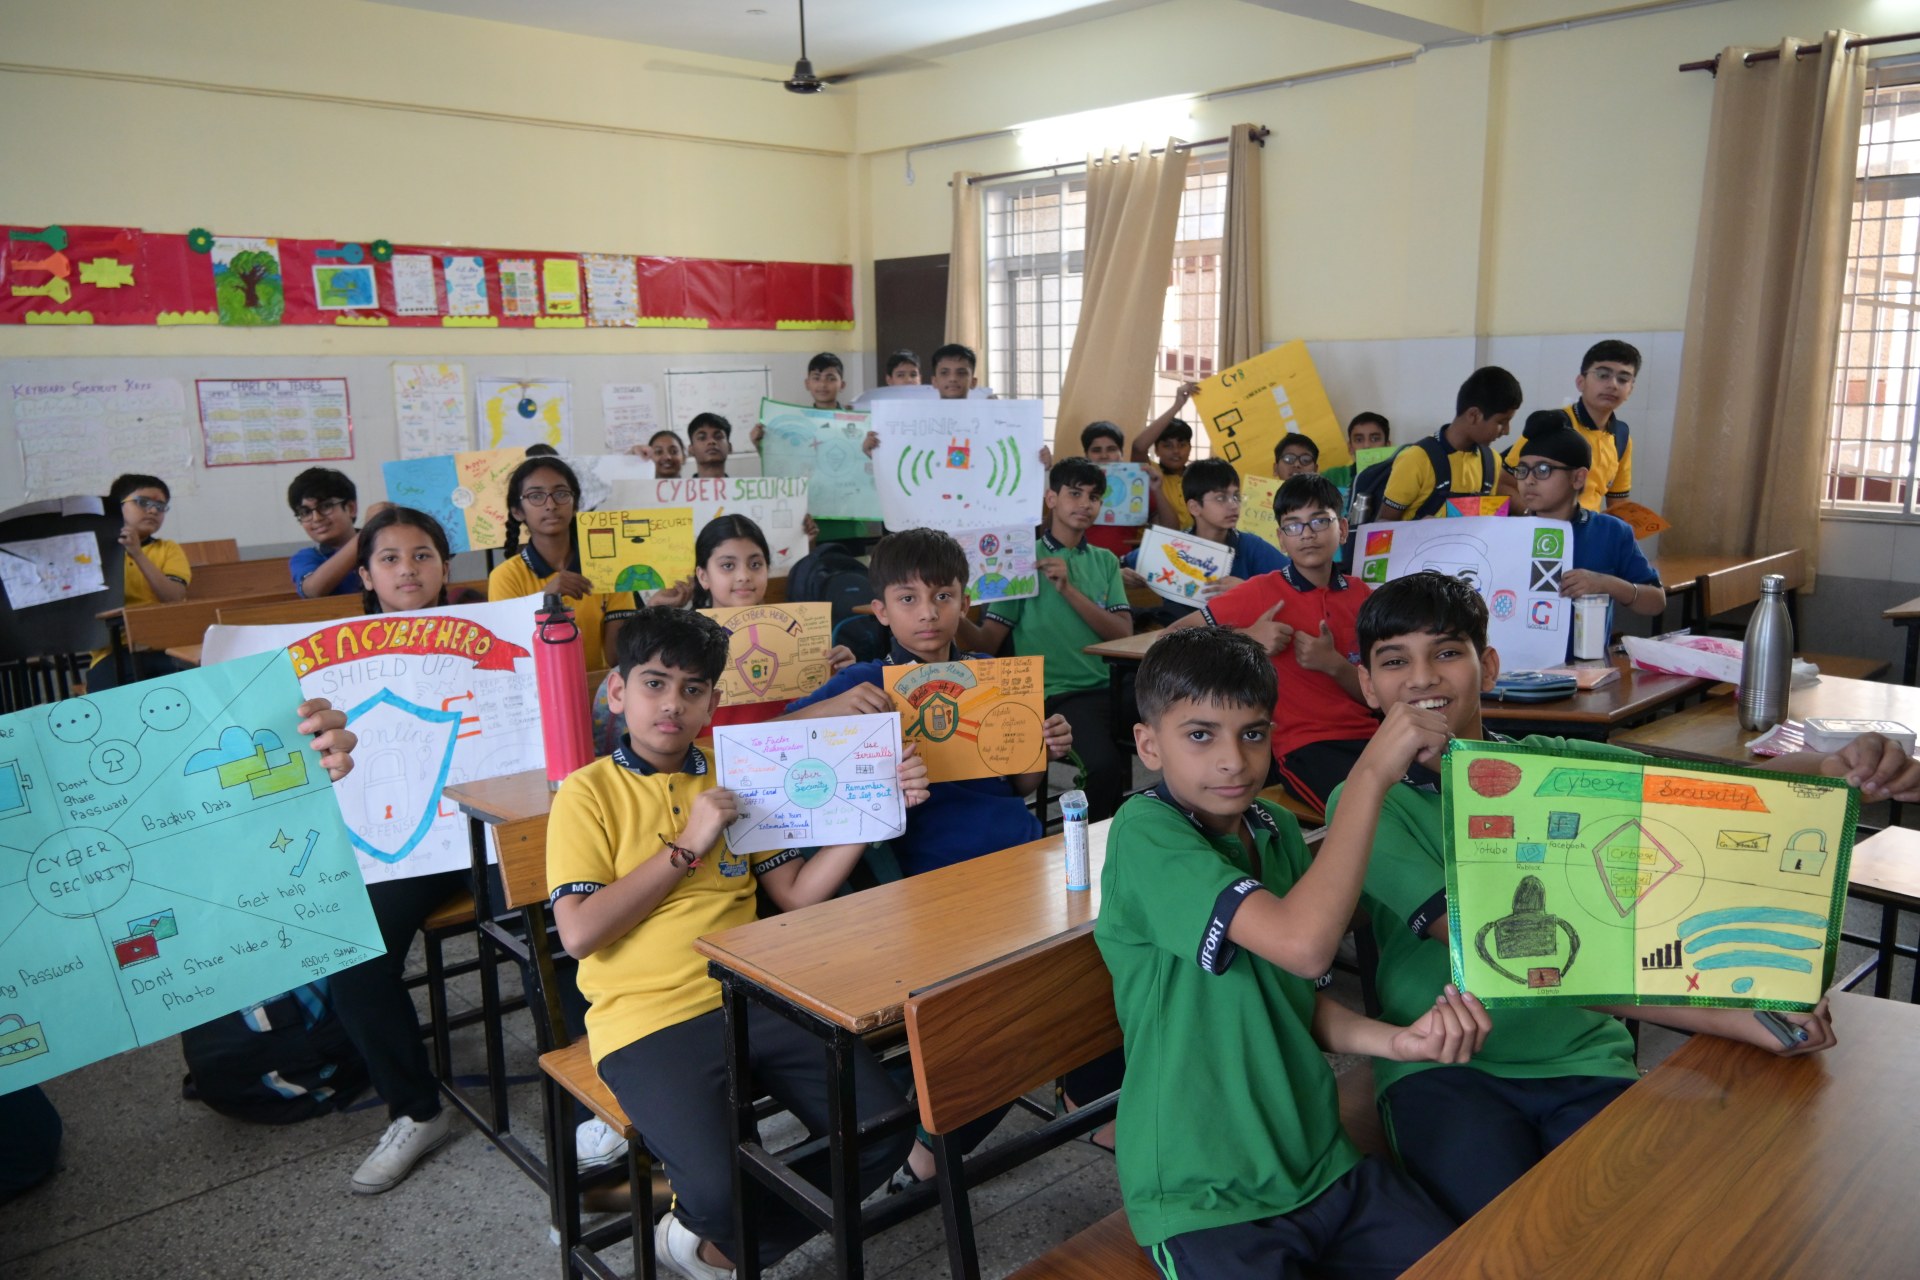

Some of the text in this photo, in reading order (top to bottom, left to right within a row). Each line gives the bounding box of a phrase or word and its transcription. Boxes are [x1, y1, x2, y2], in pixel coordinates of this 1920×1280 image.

[655, 476, 808, 503] CYBER SECURITY
[579, 511, 630, 527] CYBER
[289, 617, 492, 678] BE A CYBER HERO
[322, 656, 408, 695] SHIELD
[790, 769, 822, 785] Cyber
[794, 781, 831, 794] Security
[845, 781, 886, 792] Remember
[1552, 773, 1755, 811] Cyber Security
[201, 798, 233, 816] Data
[358, 818, 417, 838] DEFENSE
[36, 841, 112, 875] CYBER
[48, 859, 133, 899] SECURITY
[237, 869, 352, 910] Get help from
[294, 900, 342, 922] Police
[183, 952, 225, 977] Share
[230, 938, 271, 958] Video
[301, 953, 330, 969] ABDUS
[18, 954, 85, 988] Password
[311, 966, 327, 977] 7D
